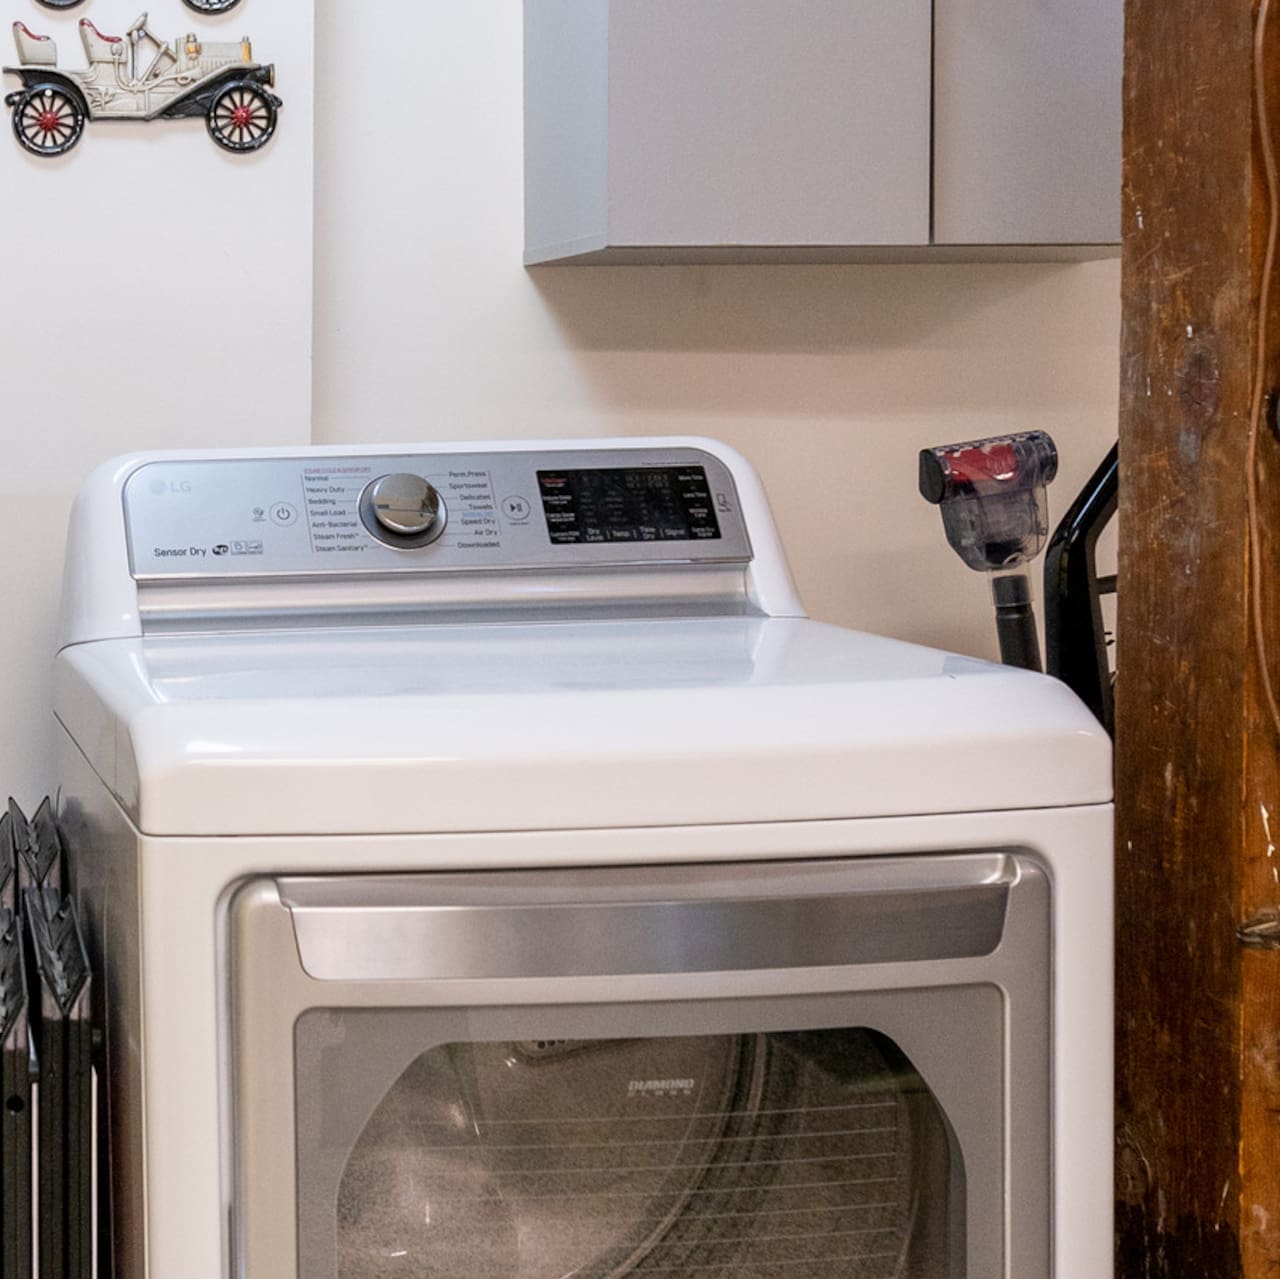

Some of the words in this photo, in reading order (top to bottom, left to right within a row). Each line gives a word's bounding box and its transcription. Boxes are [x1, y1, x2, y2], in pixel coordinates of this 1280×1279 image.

[154, 548, 187, 557] Sensor
[189, 547, 207, 557] Dry
[628, 1079, 695, 1090] DIAMOND
